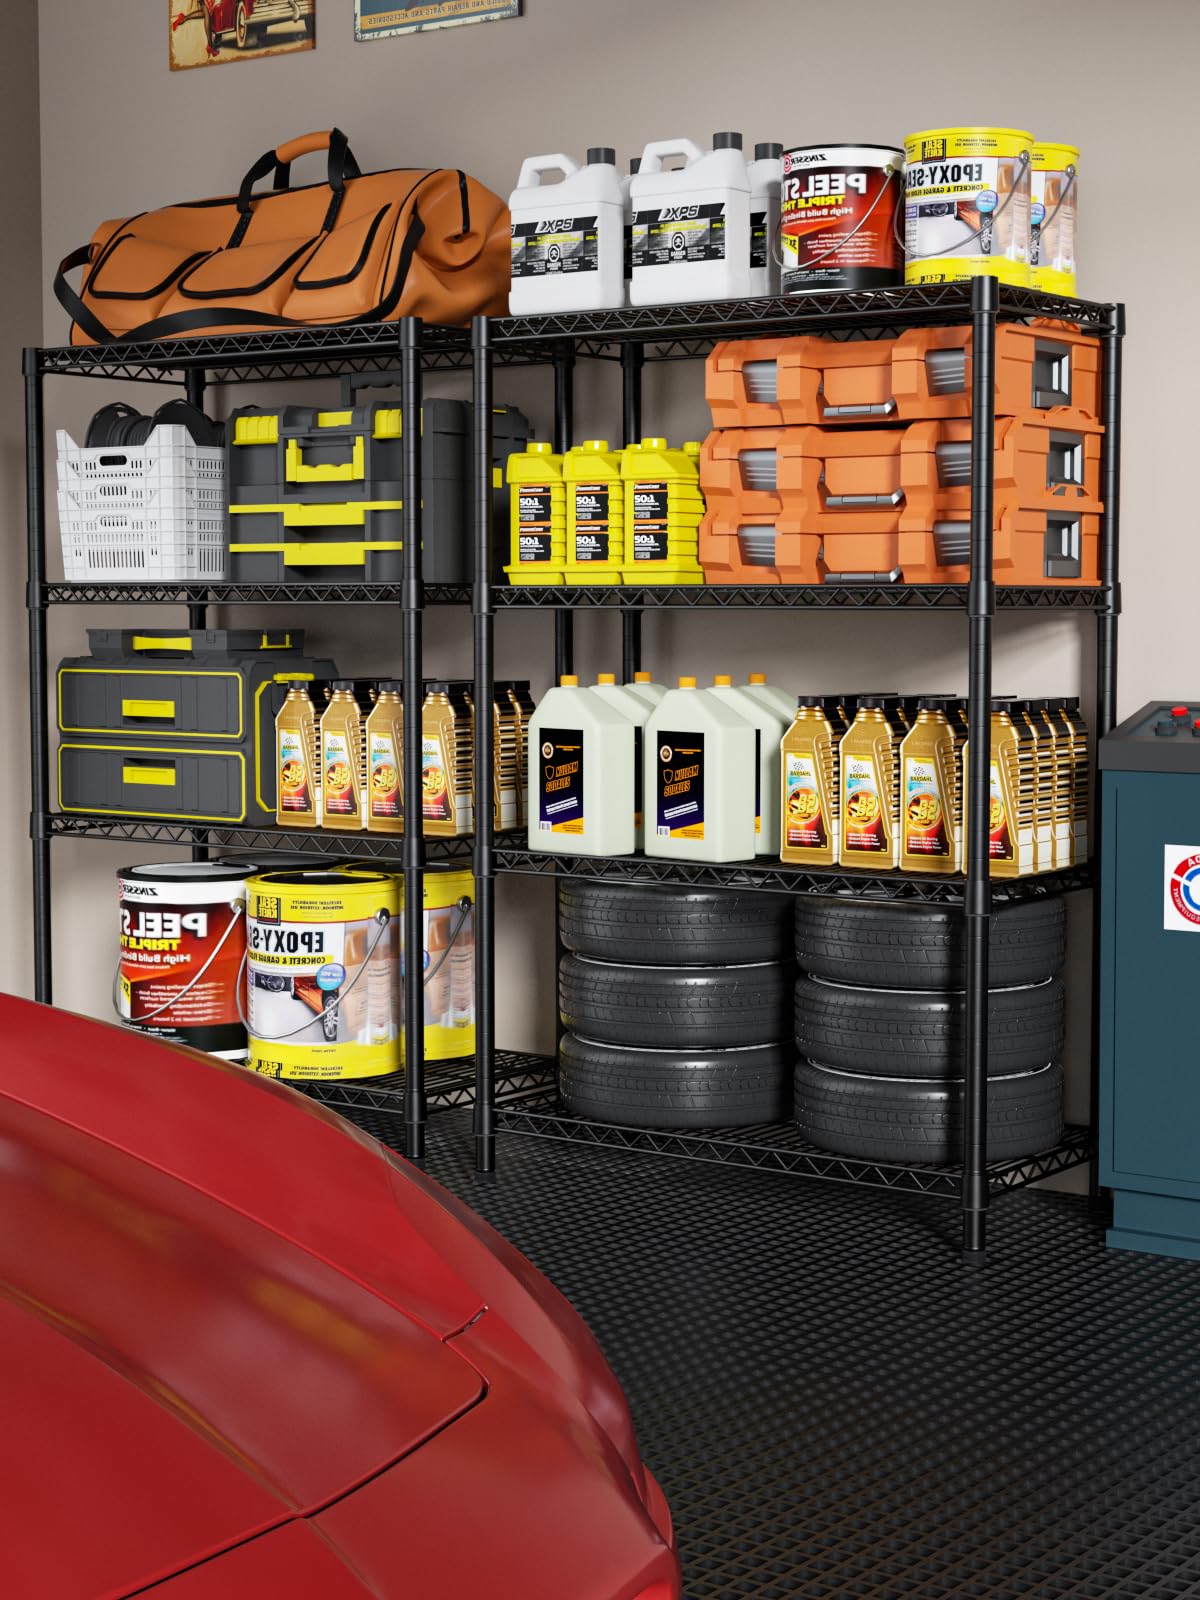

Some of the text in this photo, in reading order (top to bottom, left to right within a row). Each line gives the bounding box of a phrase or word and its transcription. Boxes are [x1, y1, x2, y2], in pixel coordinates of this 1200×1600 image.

[670, 205, 699, 220] XPS
[545, 218, 573, 233] XPS
[519, 497, 540, 506] 50:1
[576, 495, 597, 505] 50:1
[634, 494, 656, 504] 50:1
[519, 536, 540, 545] 50:1
[576, 535, 597, 545] 50:1
[634, 534, 656, 544] 50:1
